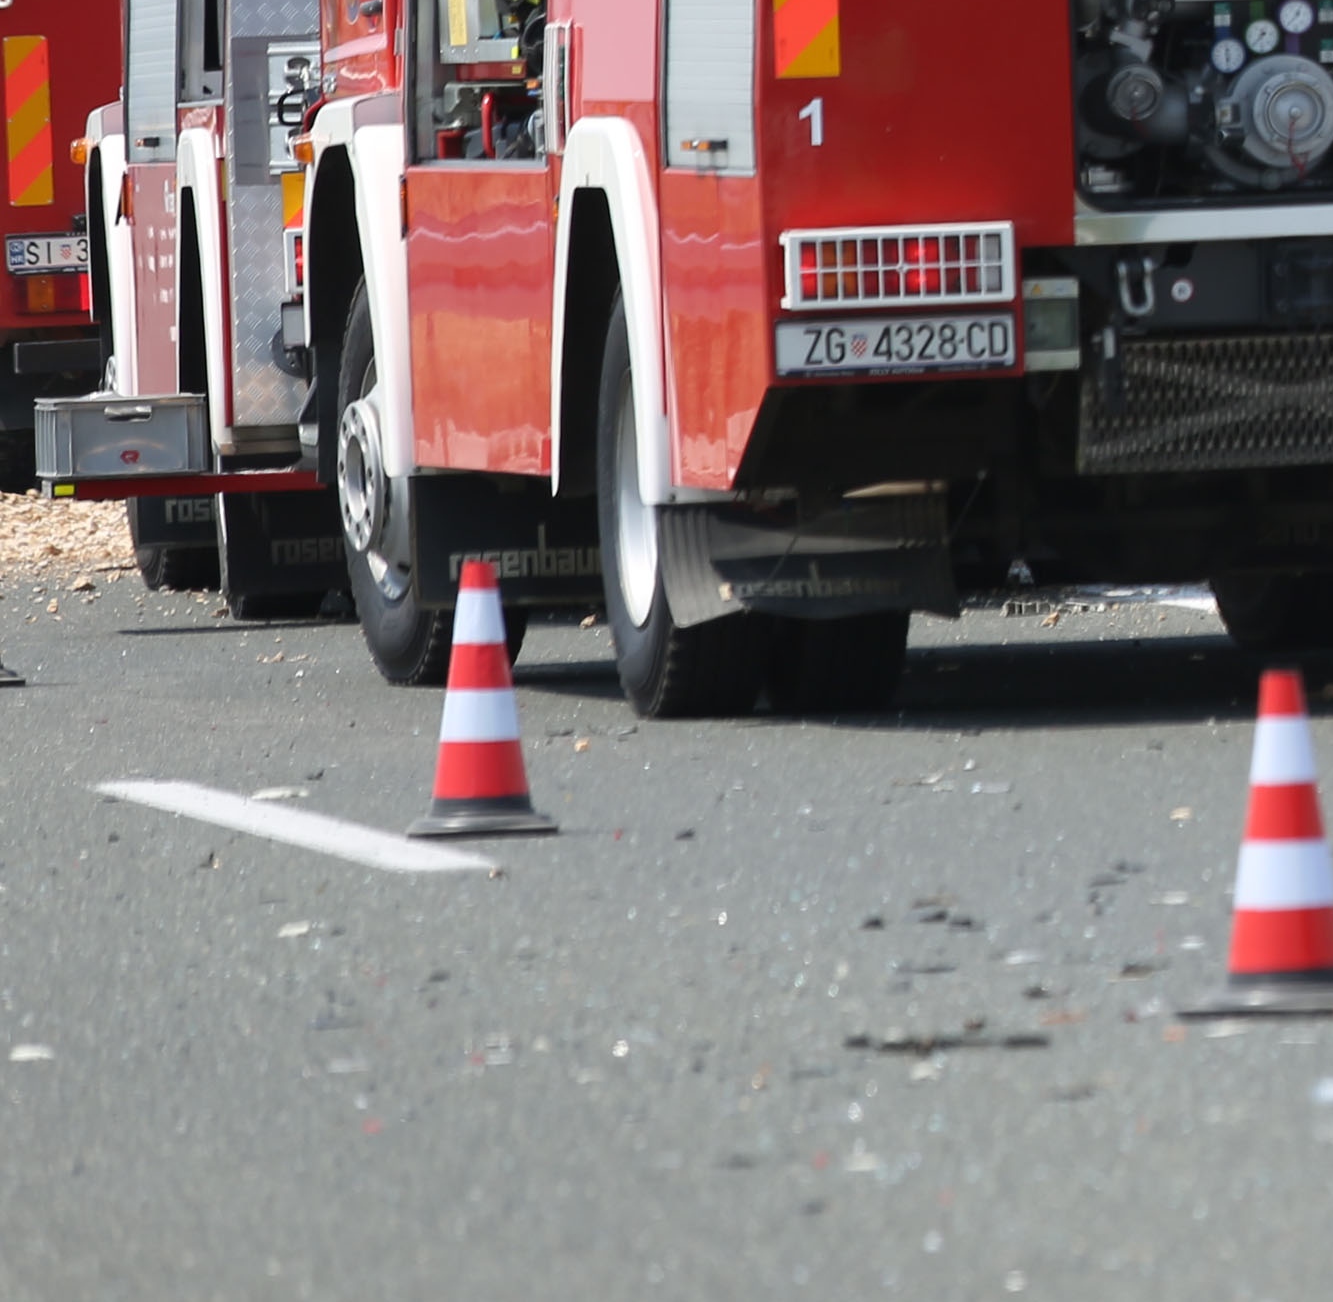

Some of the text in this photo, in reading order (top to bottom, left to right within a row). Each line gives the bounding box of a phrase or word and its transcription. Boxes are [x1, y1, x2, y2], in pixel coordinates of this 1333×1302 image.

[798, 97, 823, 147] 1
[803, 327, 847, 366] ZG
[164, 499, 217, 524] ros
